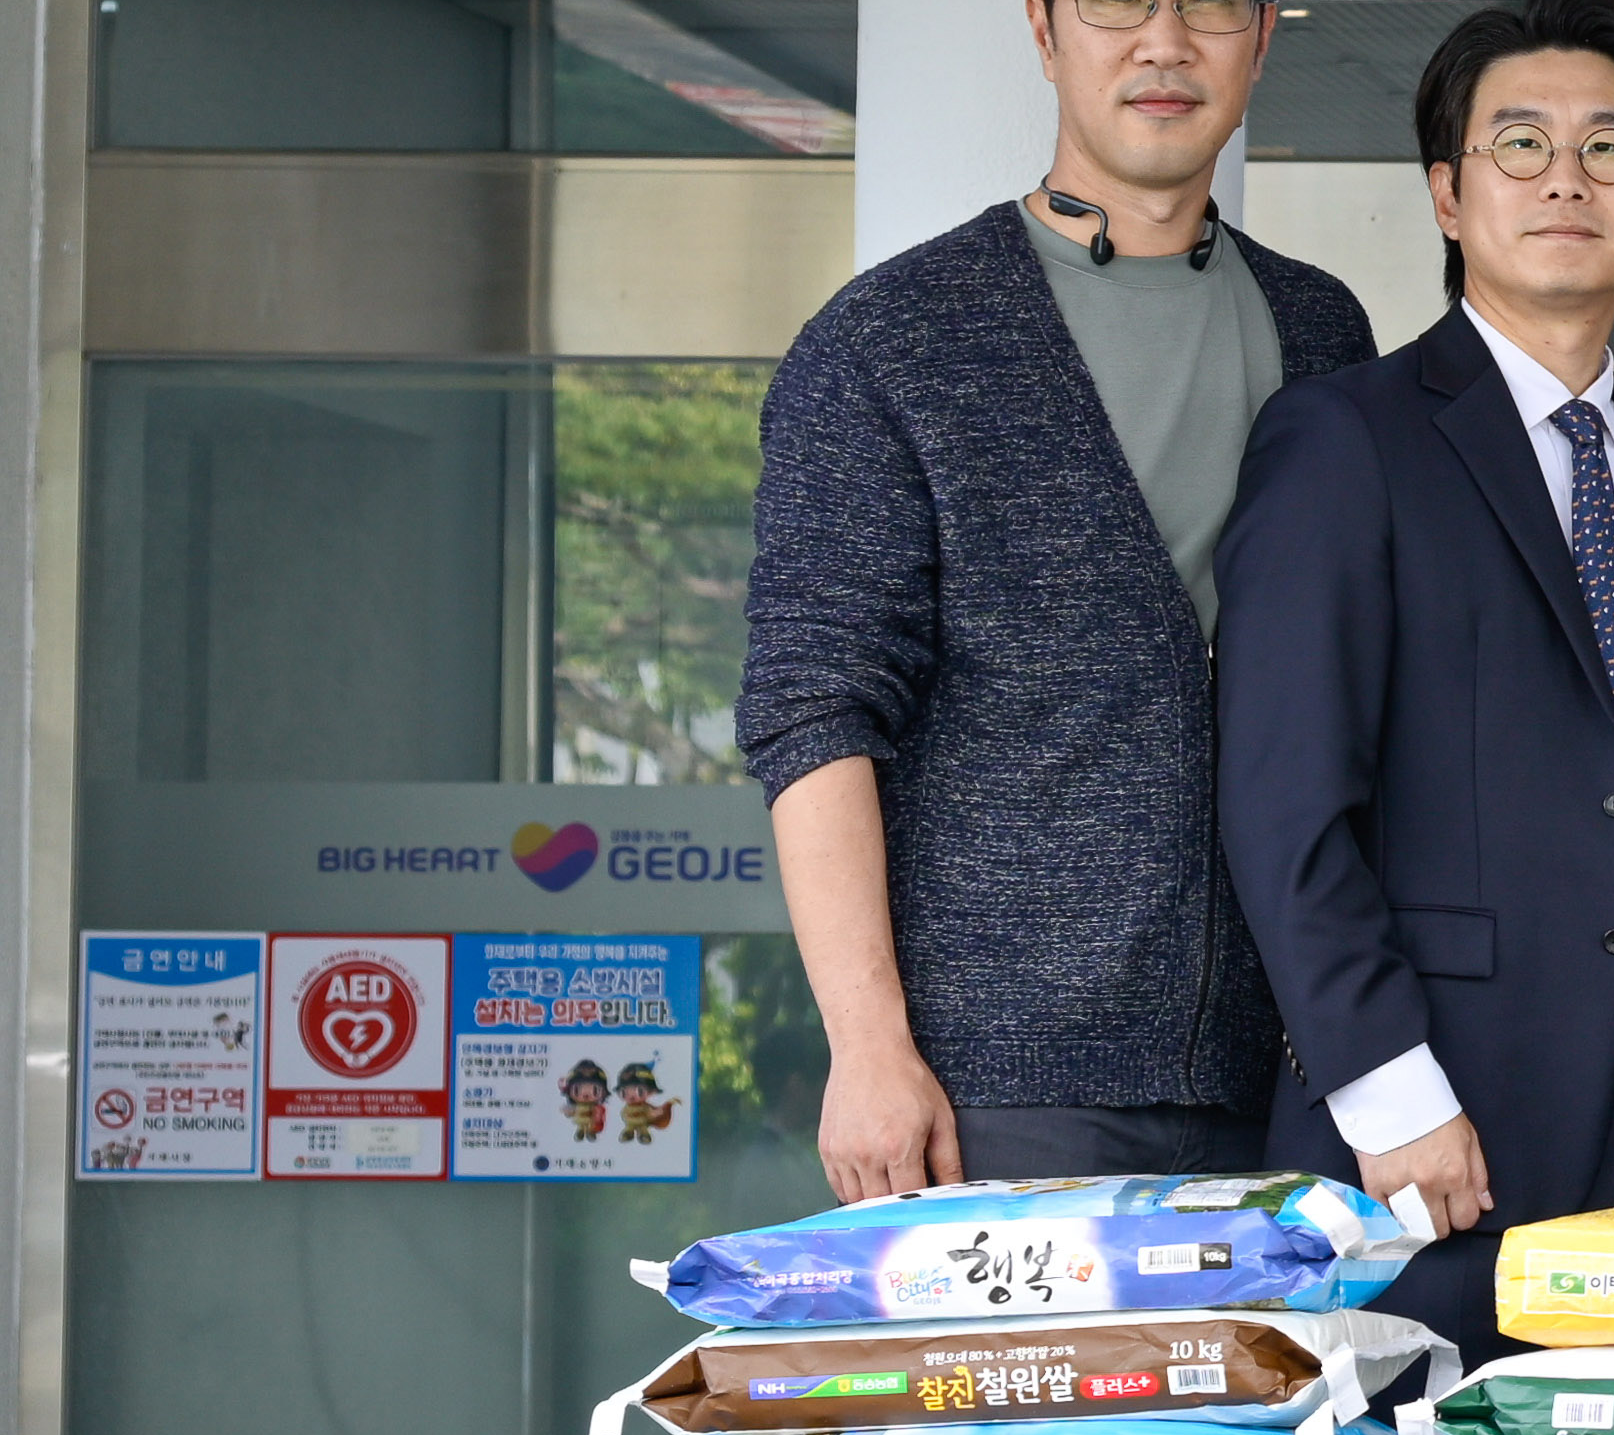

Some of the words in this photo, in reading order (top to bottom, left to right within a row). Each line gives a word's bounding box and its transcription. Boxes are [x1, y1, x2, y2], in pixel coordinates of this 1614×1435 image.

[317, 847, 376, 874] BIG
[383, 847, 500, 874] HEART
[607, 846, 765, 882] GEOJE
[325, 974, 392, 1003] AED
[488, 967, 564, 997] 주택용
[567, 967, 665, 997] 소방시설
[474, 998, 546, 1027] 설치는
[143, 1086, 245, 1114] 금연구역
[142, 1118, 166, 1132] NO
[171, 1117, 245, 1132] SMOKING
[947, 1230, 1064, 1304] 행복
[1169, 1342, 1192, 1360] 10
[1195, 1339, 1223, 1364] kg
[757, 1381, 786, 1396] NH
[976, 1362, 1078, 1406] 철원쌀
